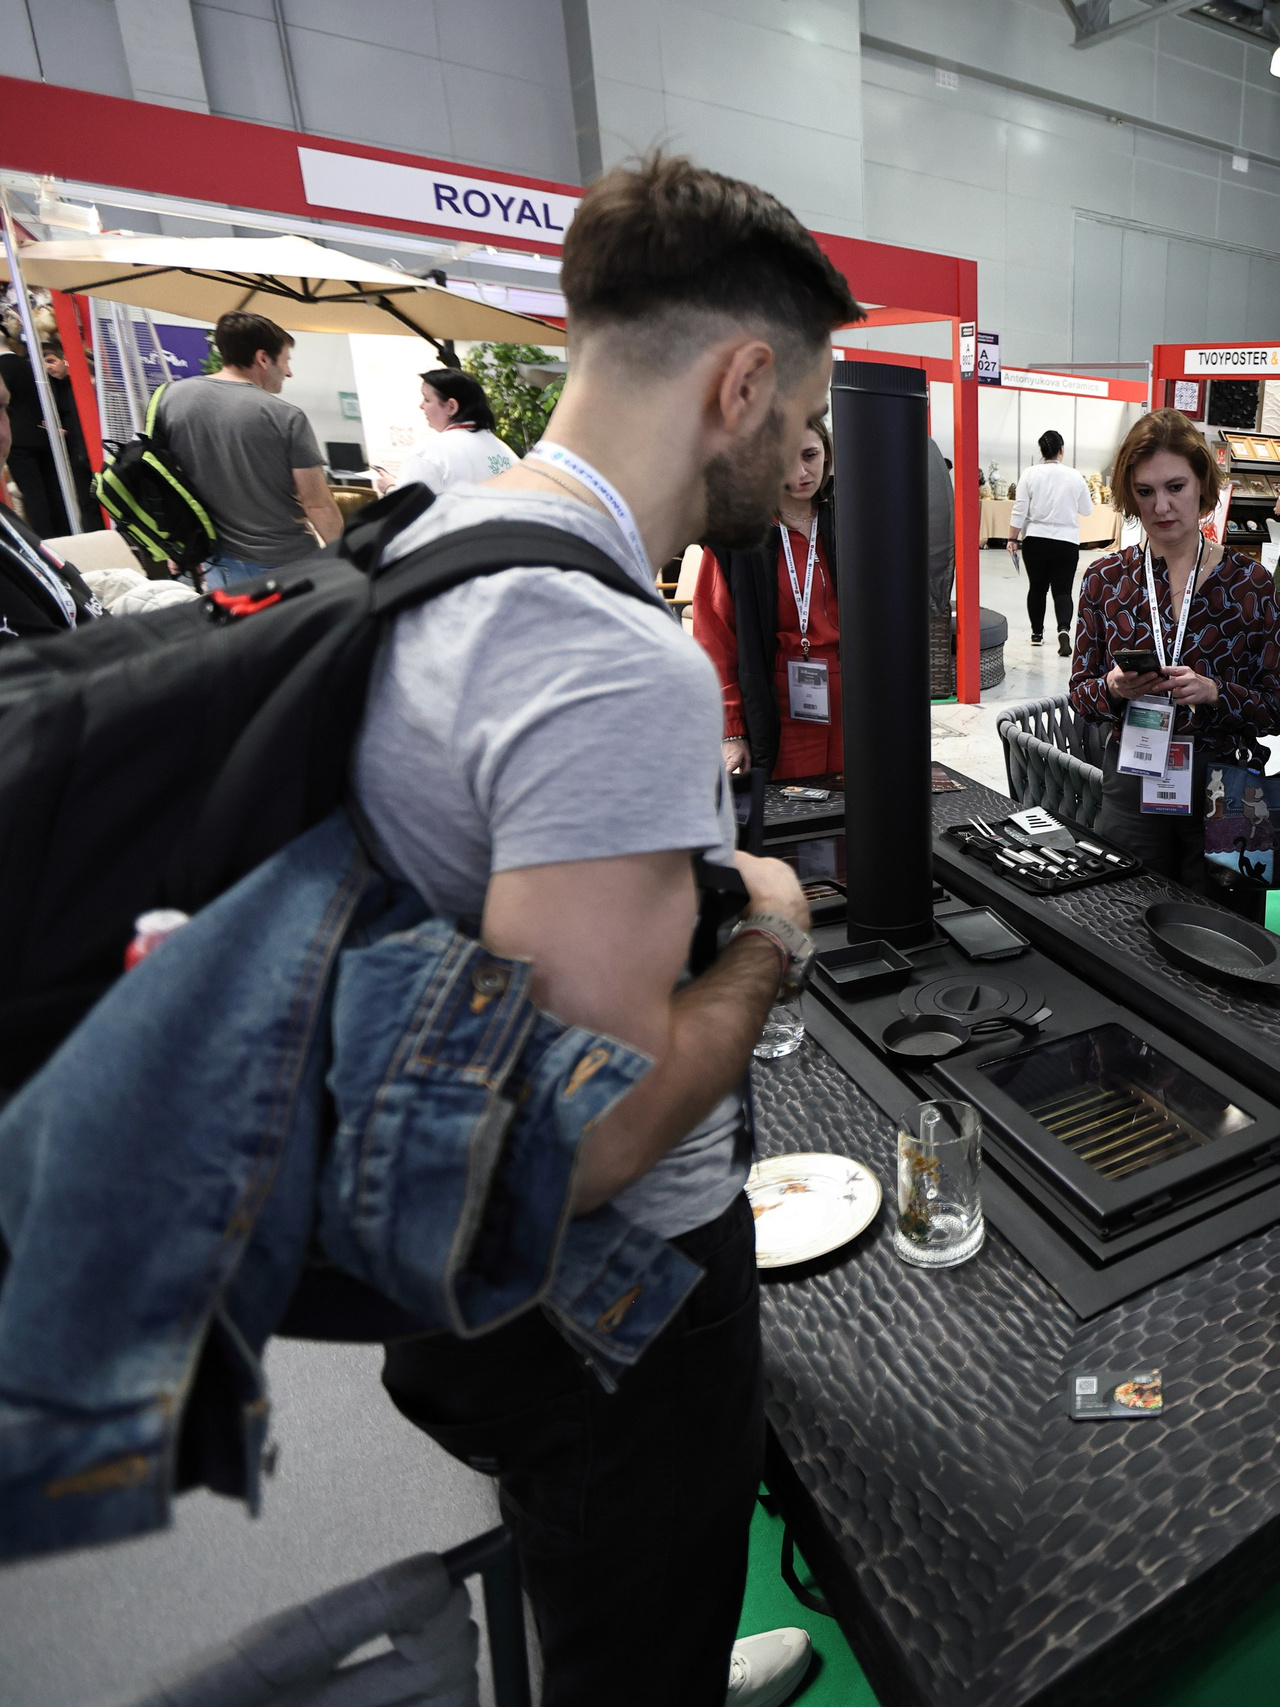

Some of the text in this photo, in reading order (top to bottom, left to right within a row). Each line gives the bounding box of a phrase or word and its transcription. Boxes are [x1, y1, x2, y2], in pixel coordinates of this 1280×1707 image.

[433, 182, 564, 232] ROYAL
[980, 349, 989, 360] A
[1199, 351, 1268, 366] TVOYPOSTER
[1270, 351, 1279, 366] &
[978, 360, 997, 372] 027
[1003, 373, 1100, 392] Antonyukova Ceramics
